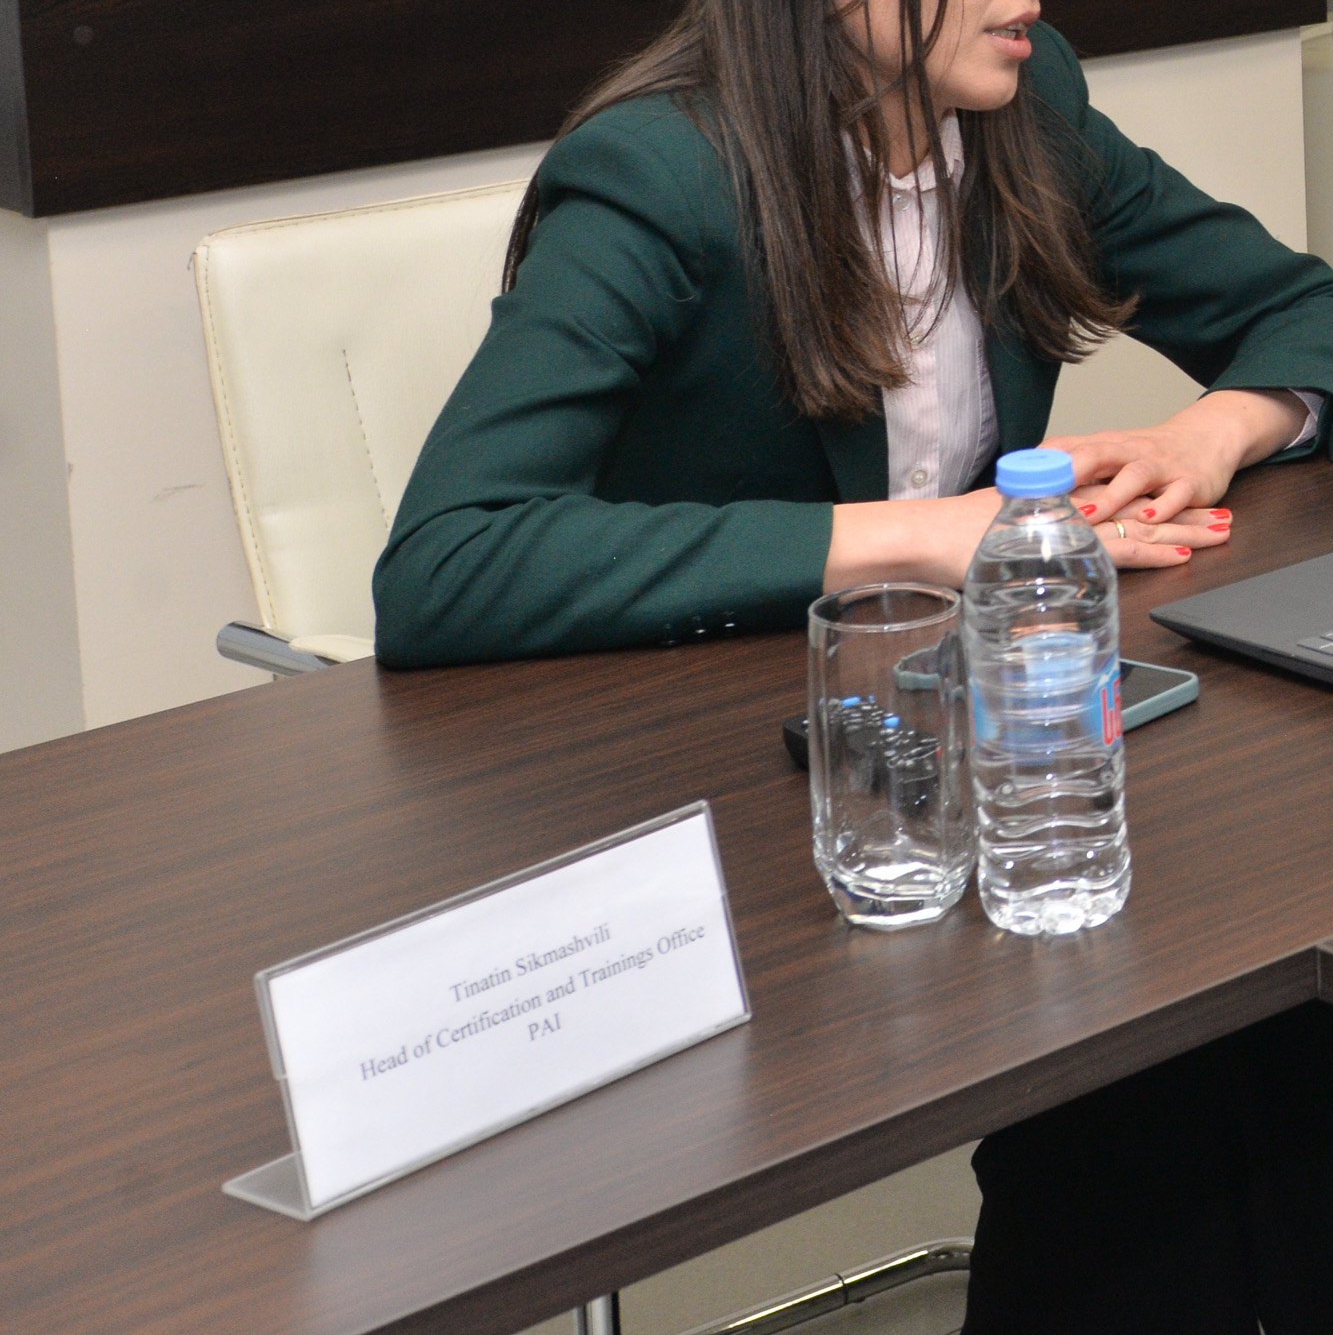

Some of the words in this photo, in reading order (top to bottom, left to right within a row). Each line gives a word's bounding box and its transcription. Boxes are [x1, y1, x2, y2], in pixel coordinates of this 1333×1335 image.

[360, 1045, 409, 1081] Head
[413, 1034, 433, 1059] of
[436, 994, 542, 1048] Certification
[546, 975, 576, 1003] and
[578, 946, 654, 988] Trainings
[656, 925, 705, 955] Office
[449, 967, 512, 1003] Tinatin
[515, 922, 611, 977] Sikmashvili
[527, 1012, 562, 1042] PAI
